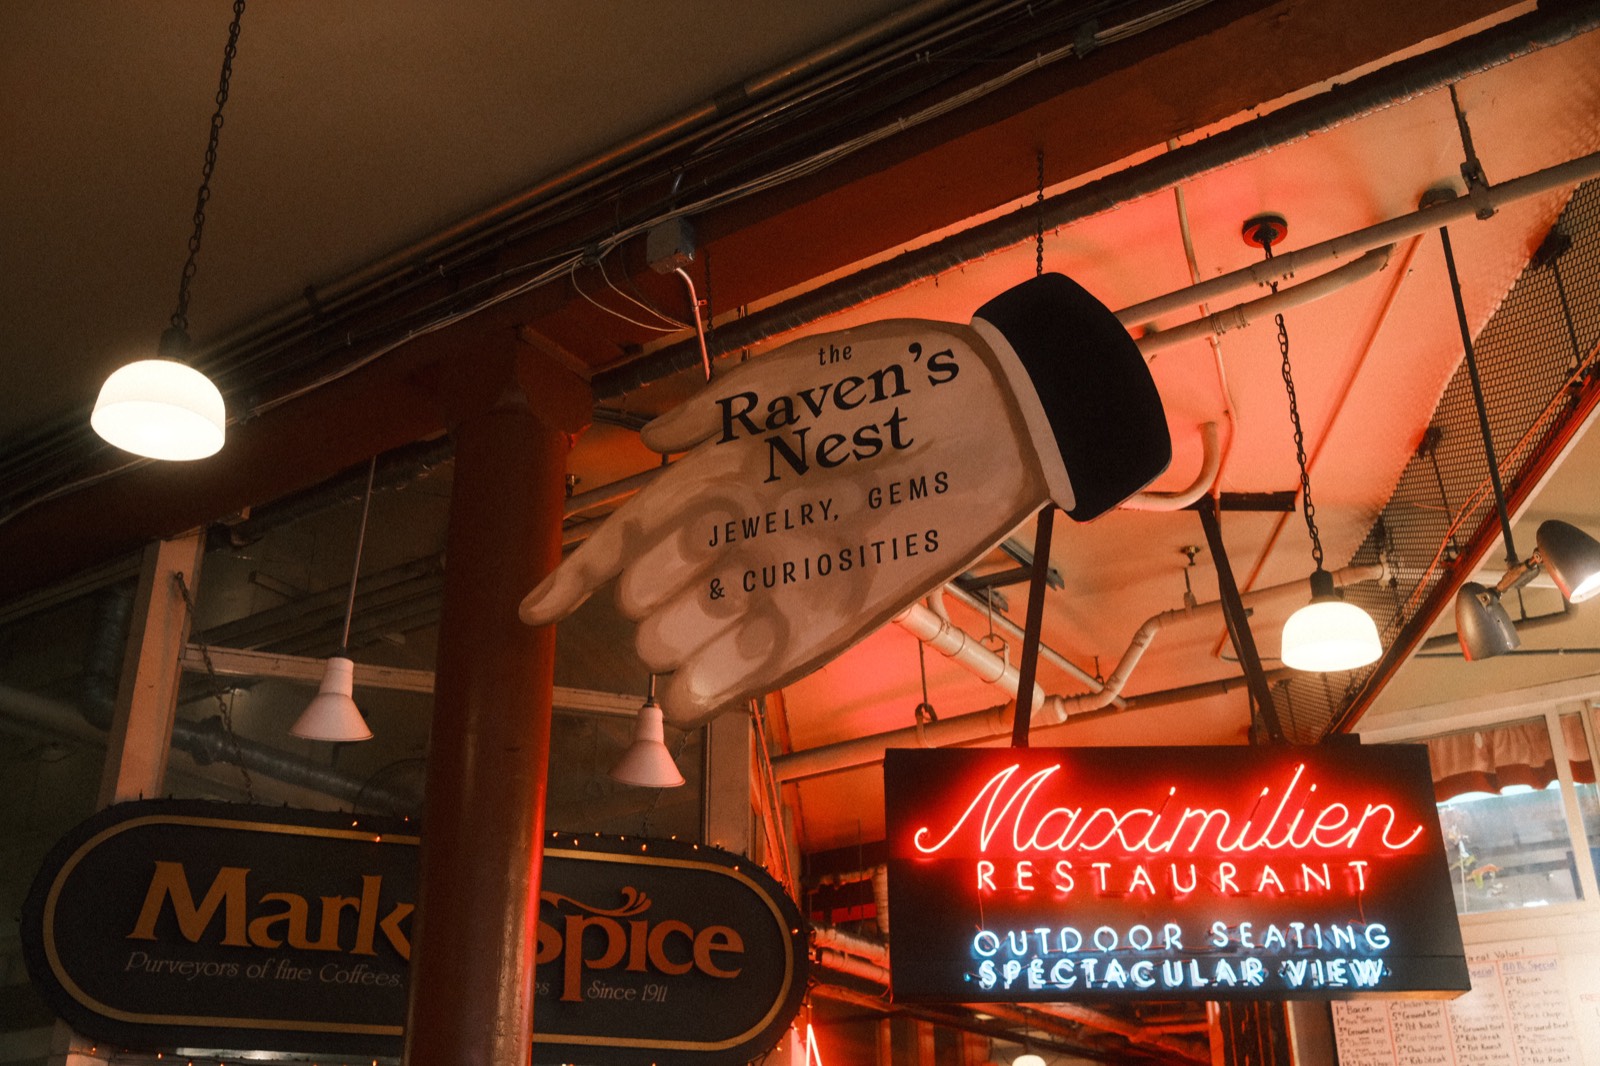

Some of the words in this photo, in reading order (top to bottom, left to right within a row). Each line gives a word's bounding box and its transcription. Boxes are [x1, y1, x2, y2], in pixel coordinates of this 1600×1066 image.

[818, 343, 853, 366] the
[715, 342, 960, 445] Raven's
[763, 406, 914, 484] Nest
[708, 498, 839, 547] JEWELRY,
[867, 471, 949, 509] GEMS
[709, 578, 725, 600] &
[742, 529, 939, 592] CURIOSITIES
[914, 762, 1424, 853] Maximilien
[976, 860, 1369, 894] RESTAURANT
[973, 923, 1183, 957] OUTDOOR
[1212, 921, 1391, 951] SEATING
[124, 951, 238, 981] Purveyors
[246, 958, 275, 978] of
[275, 959, 312, 981] fine
[977, 957, 1270, 991] SPECTACULAR
[1283, 957, 1387, 988] VIEW
[587, 980, 637, 1001] Since
[641, 984, 668, 1002] 1911
